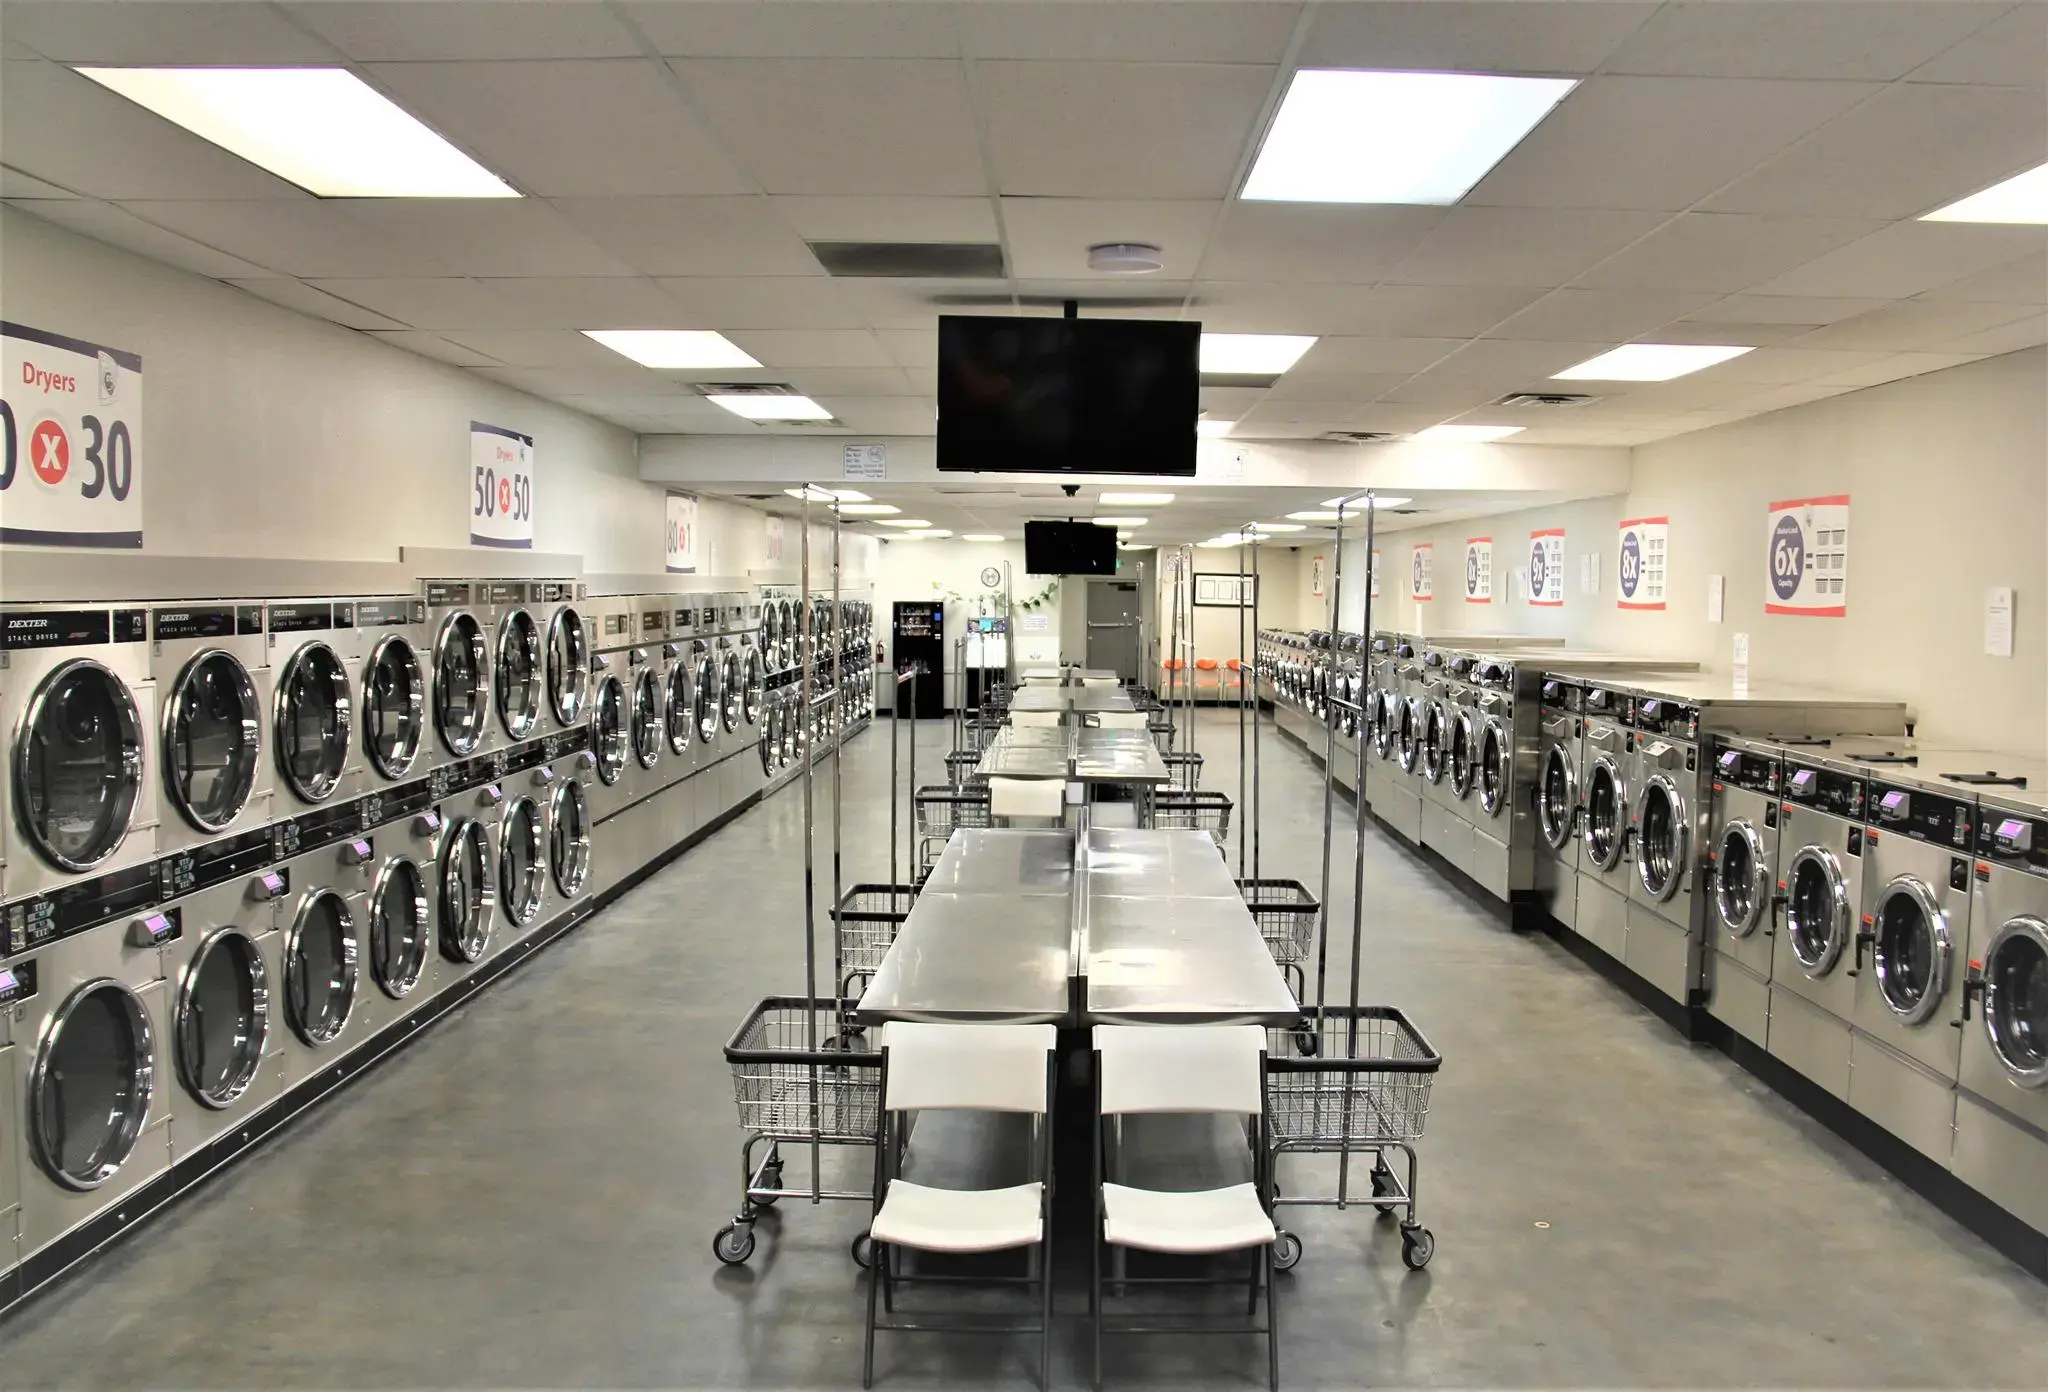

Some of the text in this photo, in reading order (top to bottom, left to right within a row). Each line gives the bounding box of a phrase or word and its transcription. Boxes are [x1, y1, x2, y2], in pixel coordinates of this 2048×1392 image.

[23, 361, 75, 393] Dryers
[81, 415, 131, 501] 30
[496, 446, 513, 462] Dryers
[475, 466, 495, 517] 50
[513, 474, 530, 521] 50
[668, 519, 678, 554] 80
[1533, 557, 1543, 582] 9x
[1622, 549, 1638, 579] 8x
[1775, 539, 1799, 576] 6x
[8, 619, 48, 628] DEXTER
[160, 613, 189, 622] DEXTER
